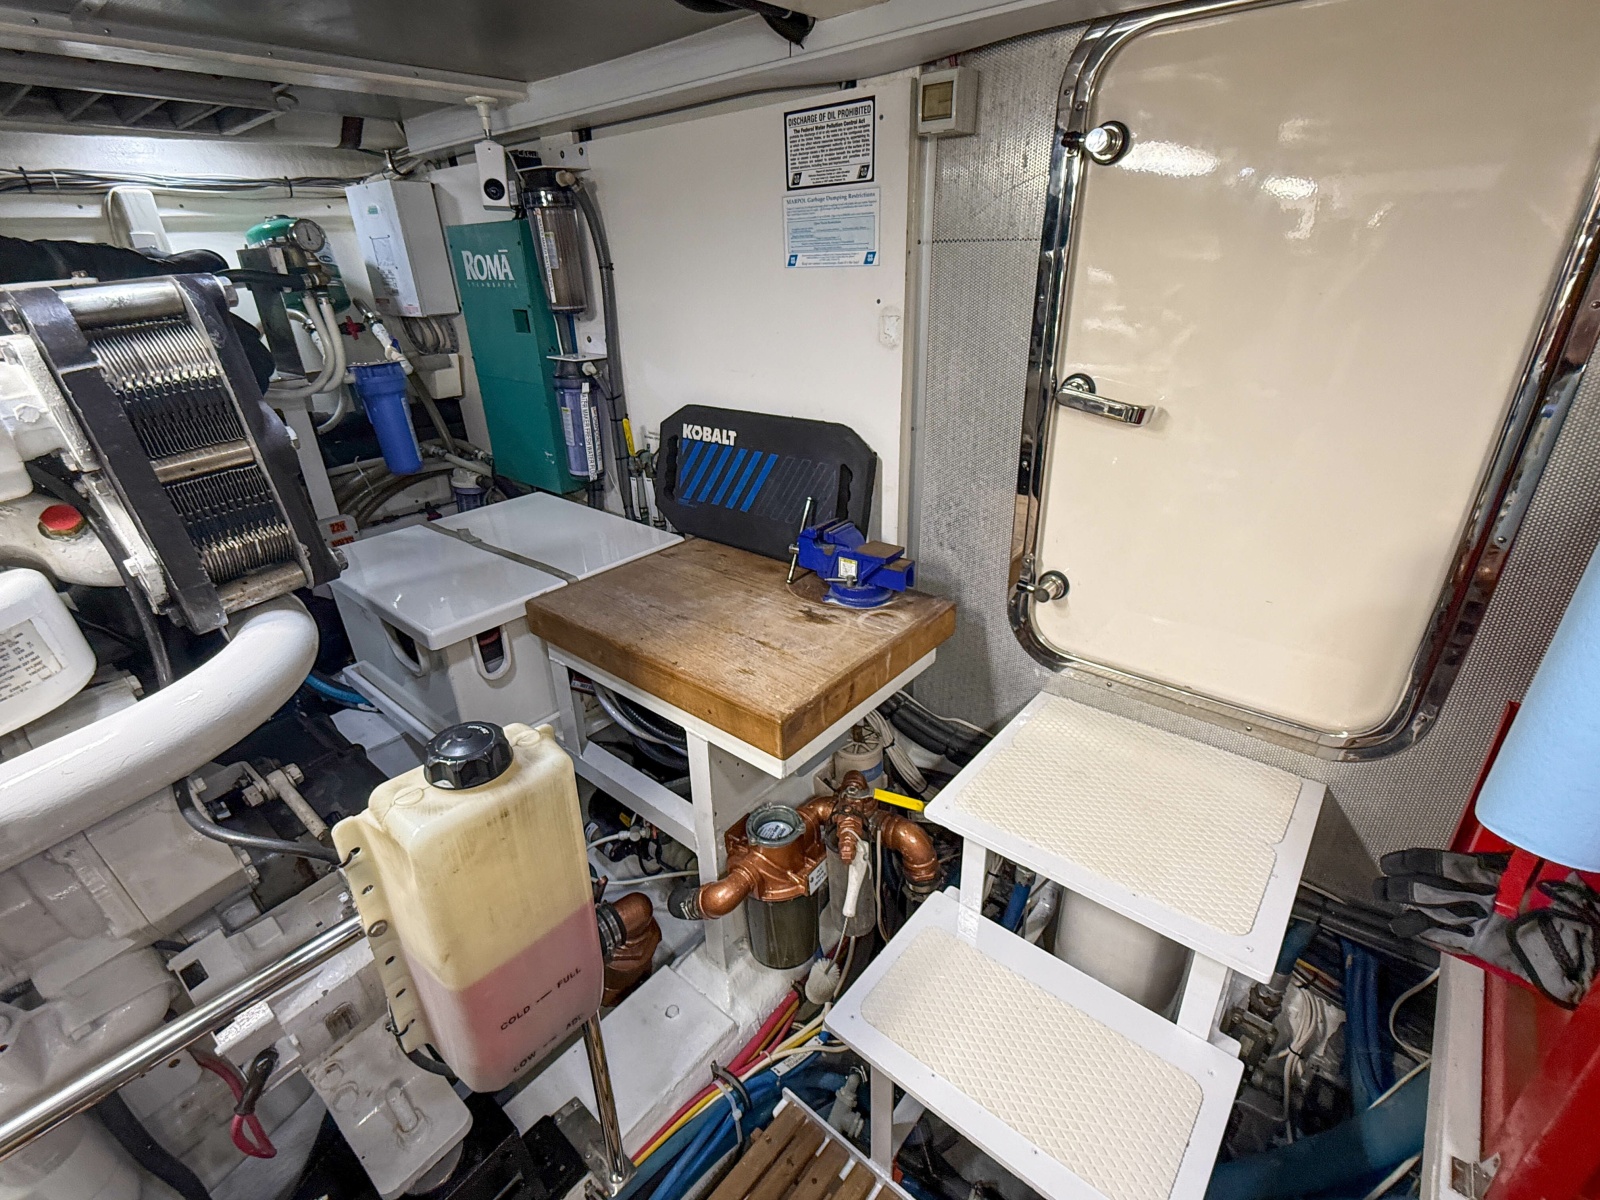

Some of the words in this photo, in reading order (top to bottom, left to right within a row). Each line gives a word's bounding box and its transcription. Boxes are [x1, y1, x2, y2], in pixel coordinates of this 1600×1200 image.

[788, 114, 818, 127] DISCHARGE
[819, 112, 826, 121] OF
[827, 111, 836, 120] OIL
[838, 105, 871, 119] PROHIBITED
[826, 121, 843, 129] Pollution
[807, 196, 825, 204] Garbage
[826, 194, 848, 202] Dumping
[682, 423, 737, 447] KOBALT
[500, 1005, 531, 1031] COLD
[557, 968, 581, 989] FULL
